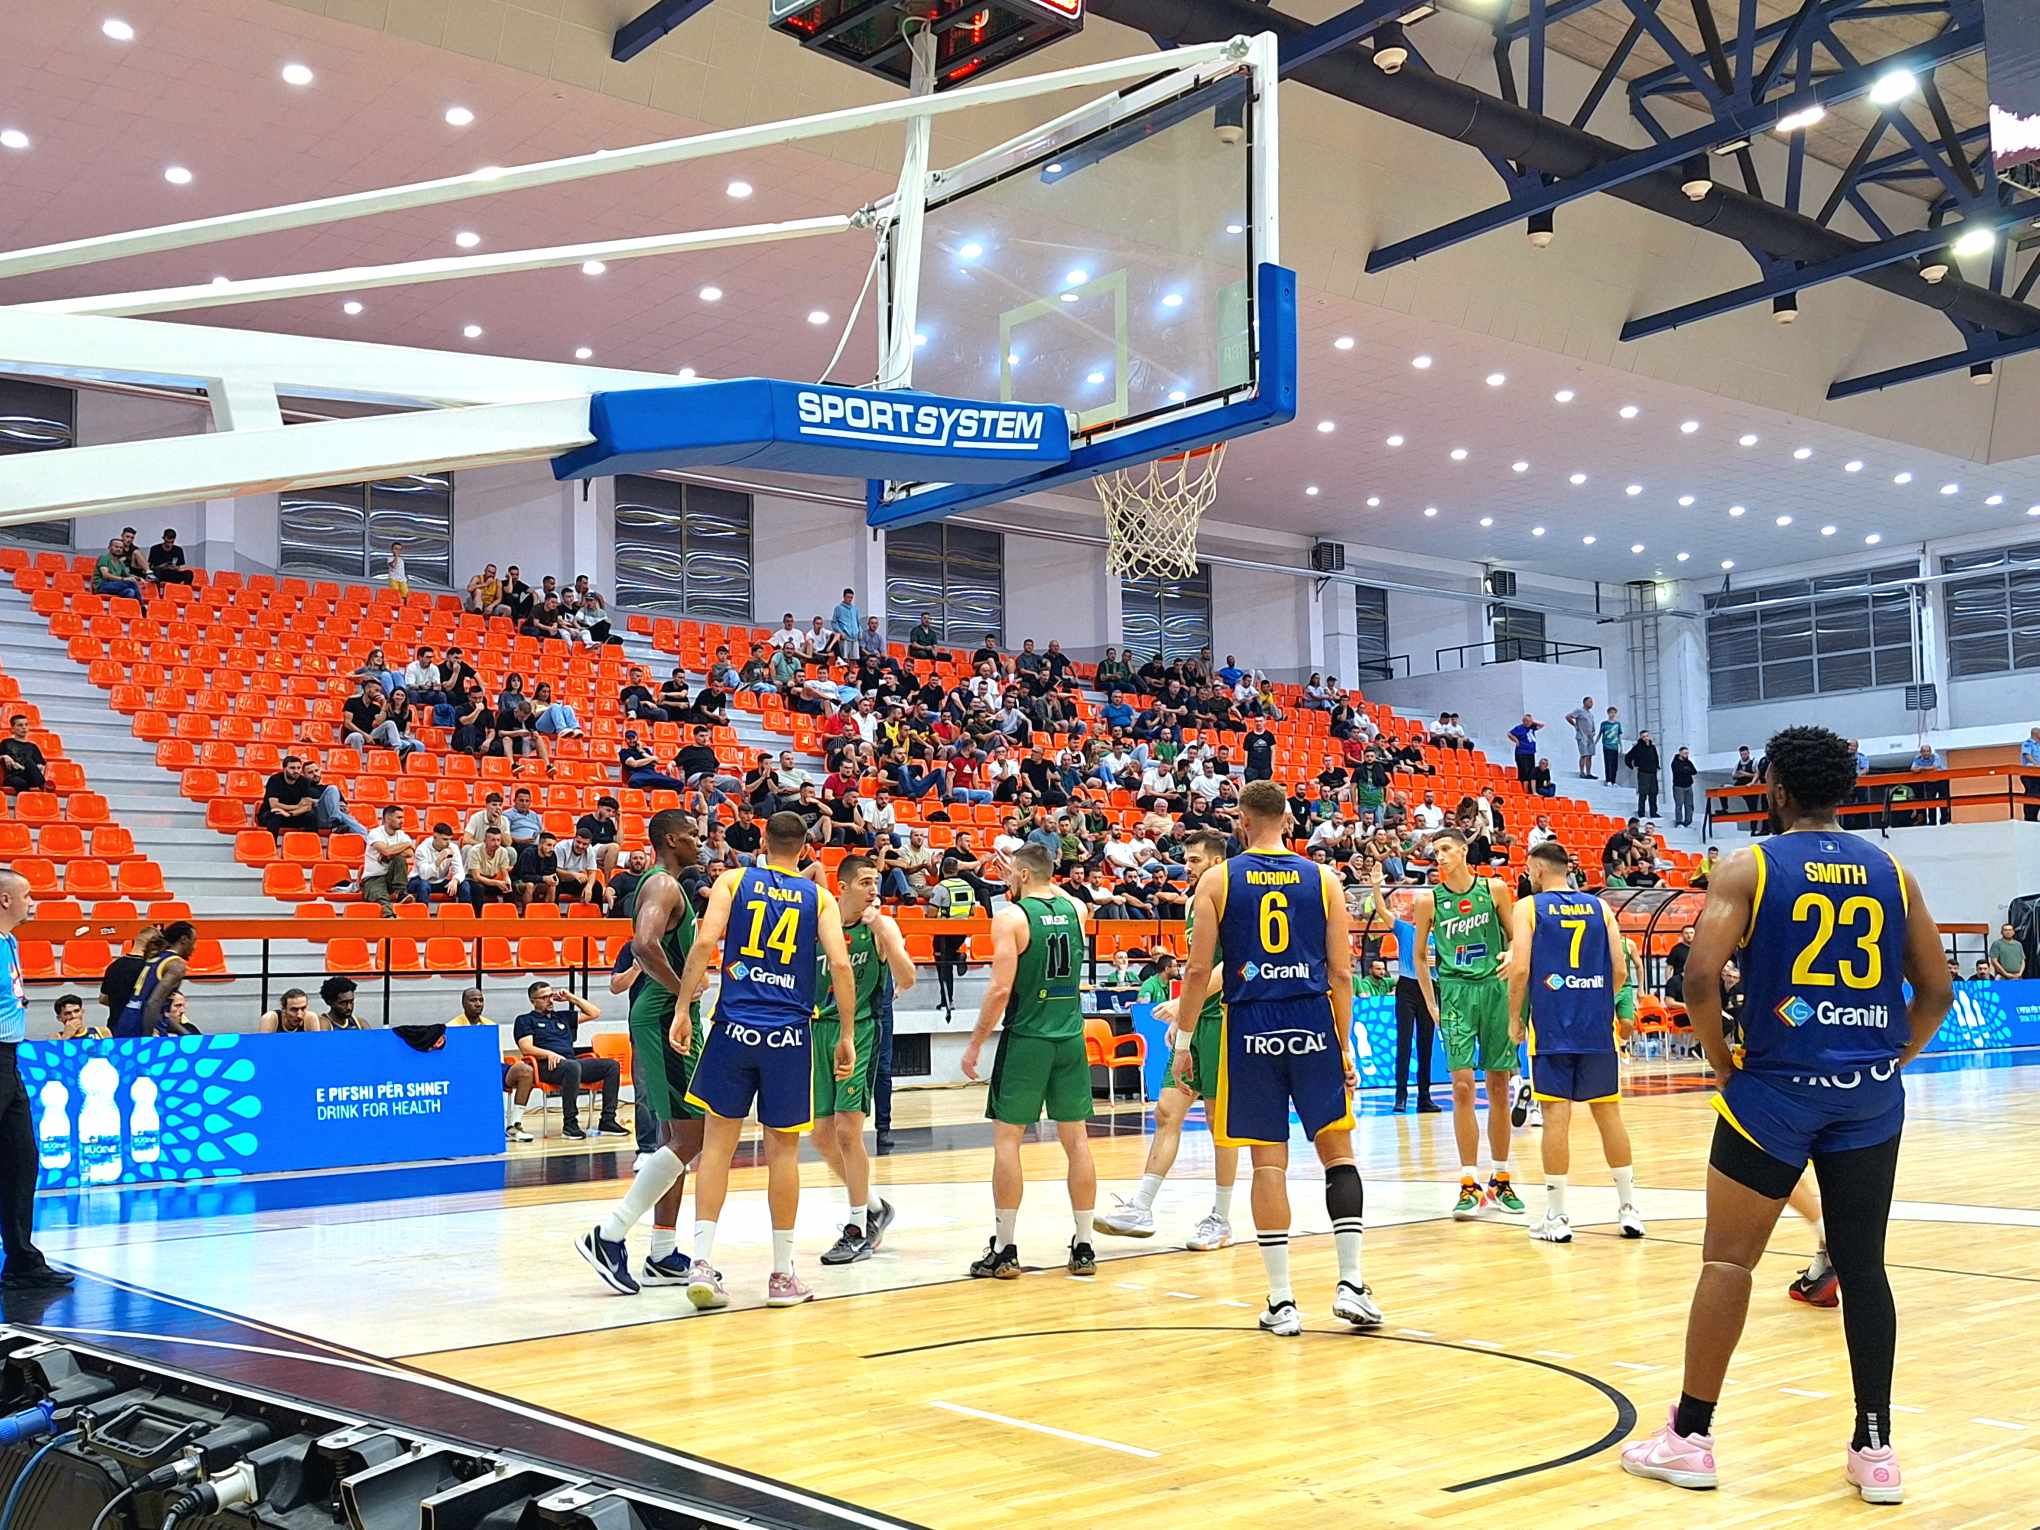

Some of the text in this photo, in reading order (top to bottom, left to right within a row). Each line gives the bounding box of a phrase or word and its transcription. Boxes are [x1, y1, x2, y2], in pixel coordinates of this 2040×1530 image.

[1246, 870, 1300, 885] MORINA
[1804, 862, 1867, 885] SMITH
[754, 881, 766, 896] D.
[1560, 904, 1594, 915] SHALA
[740, 900, 800, 965] 14
[1260, 891, 1290, 954] 6
[1440, 911, 1489, 939] Trepca
[1561, 920, 1586, 968] 7
[1792, 892, 1885, 990] 23
[1046, 932, 1072, 980] 11
[750, 967, 795, 990] Graniti
[1261, 963, 1310, 979] Graniti
[1566, 975, 1604, 988] Graniti
[1817, 1000, 1888, 1028] Graniti
[316, 1081, 450, 1102] E PIFSHI PËR SHNET
[317, 1098, 441, 1120] DRINK FOR HEALTH
